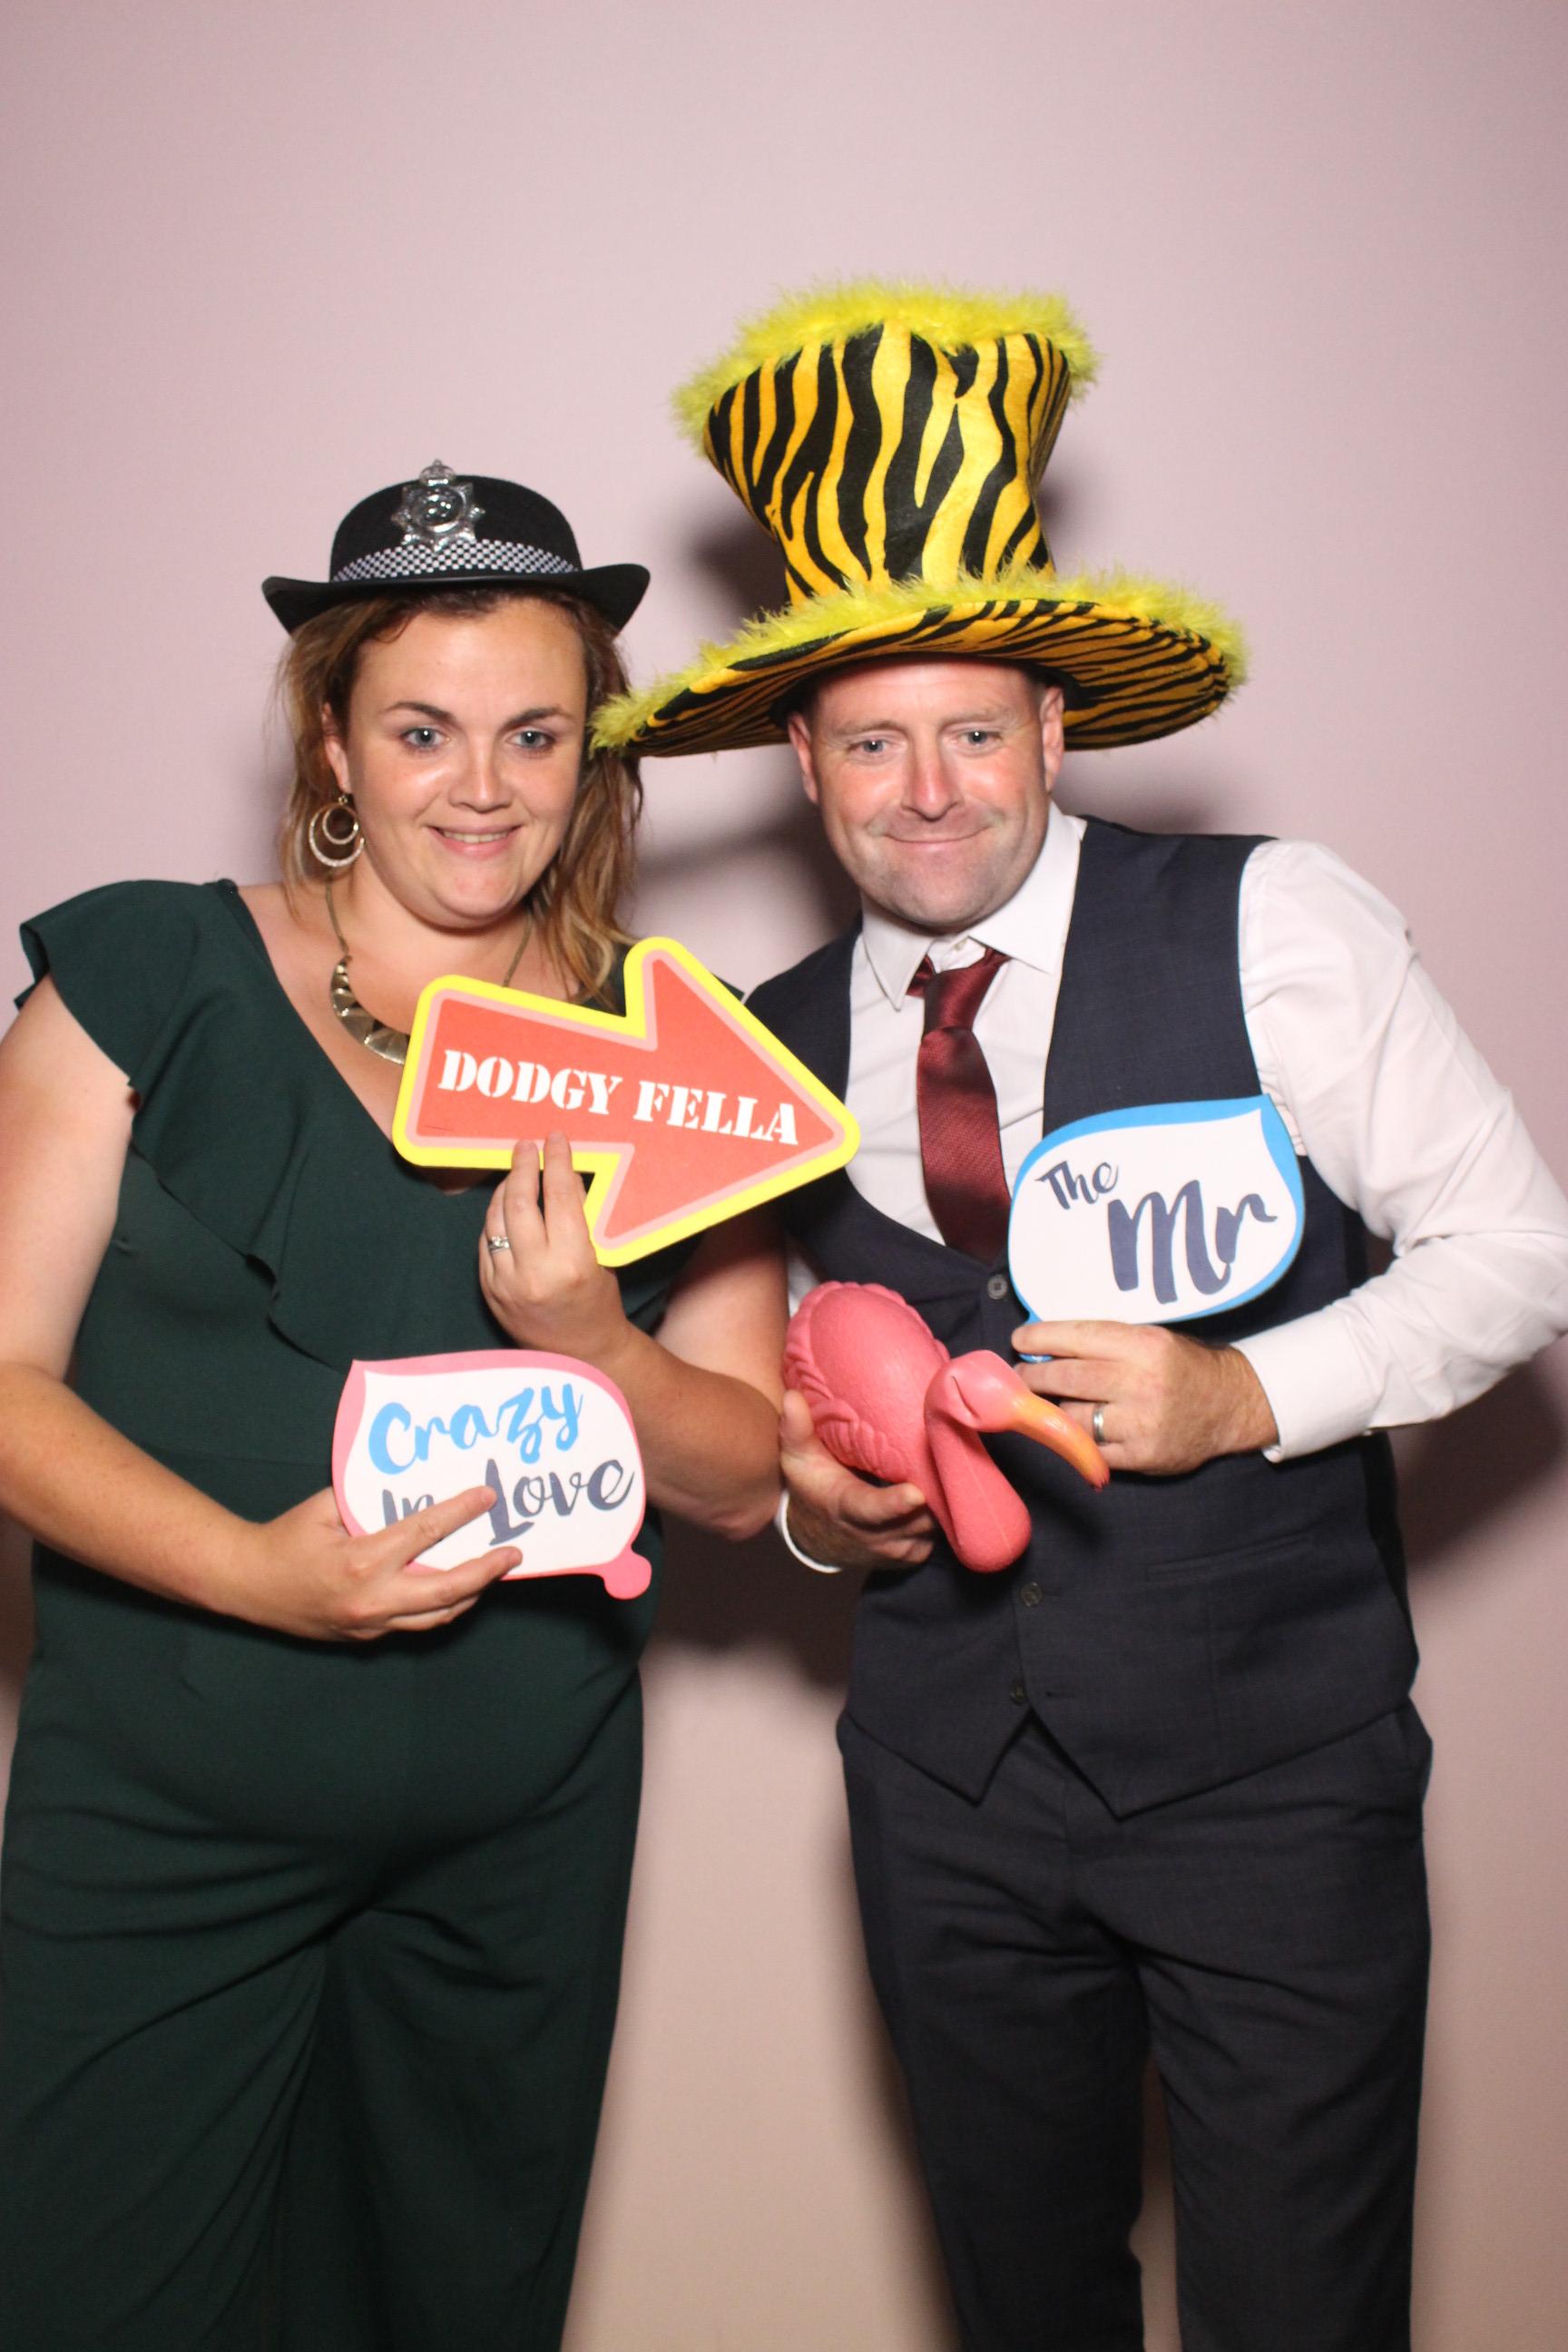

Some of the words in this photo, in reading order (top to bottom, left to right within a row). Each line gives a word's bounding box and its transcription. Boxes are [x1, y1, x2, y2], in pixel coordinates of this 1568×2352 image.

[437, 1050, 623, 1115] DODGY
[632, 1080, 799, 1145] FELLA
[1034, 1161, 1118, 1210] The
[1107, 1180, 1278, 1304] Mr
[368, 1383, 583, 1475] Crazy
[485, 1458, 635, 1546] Love
